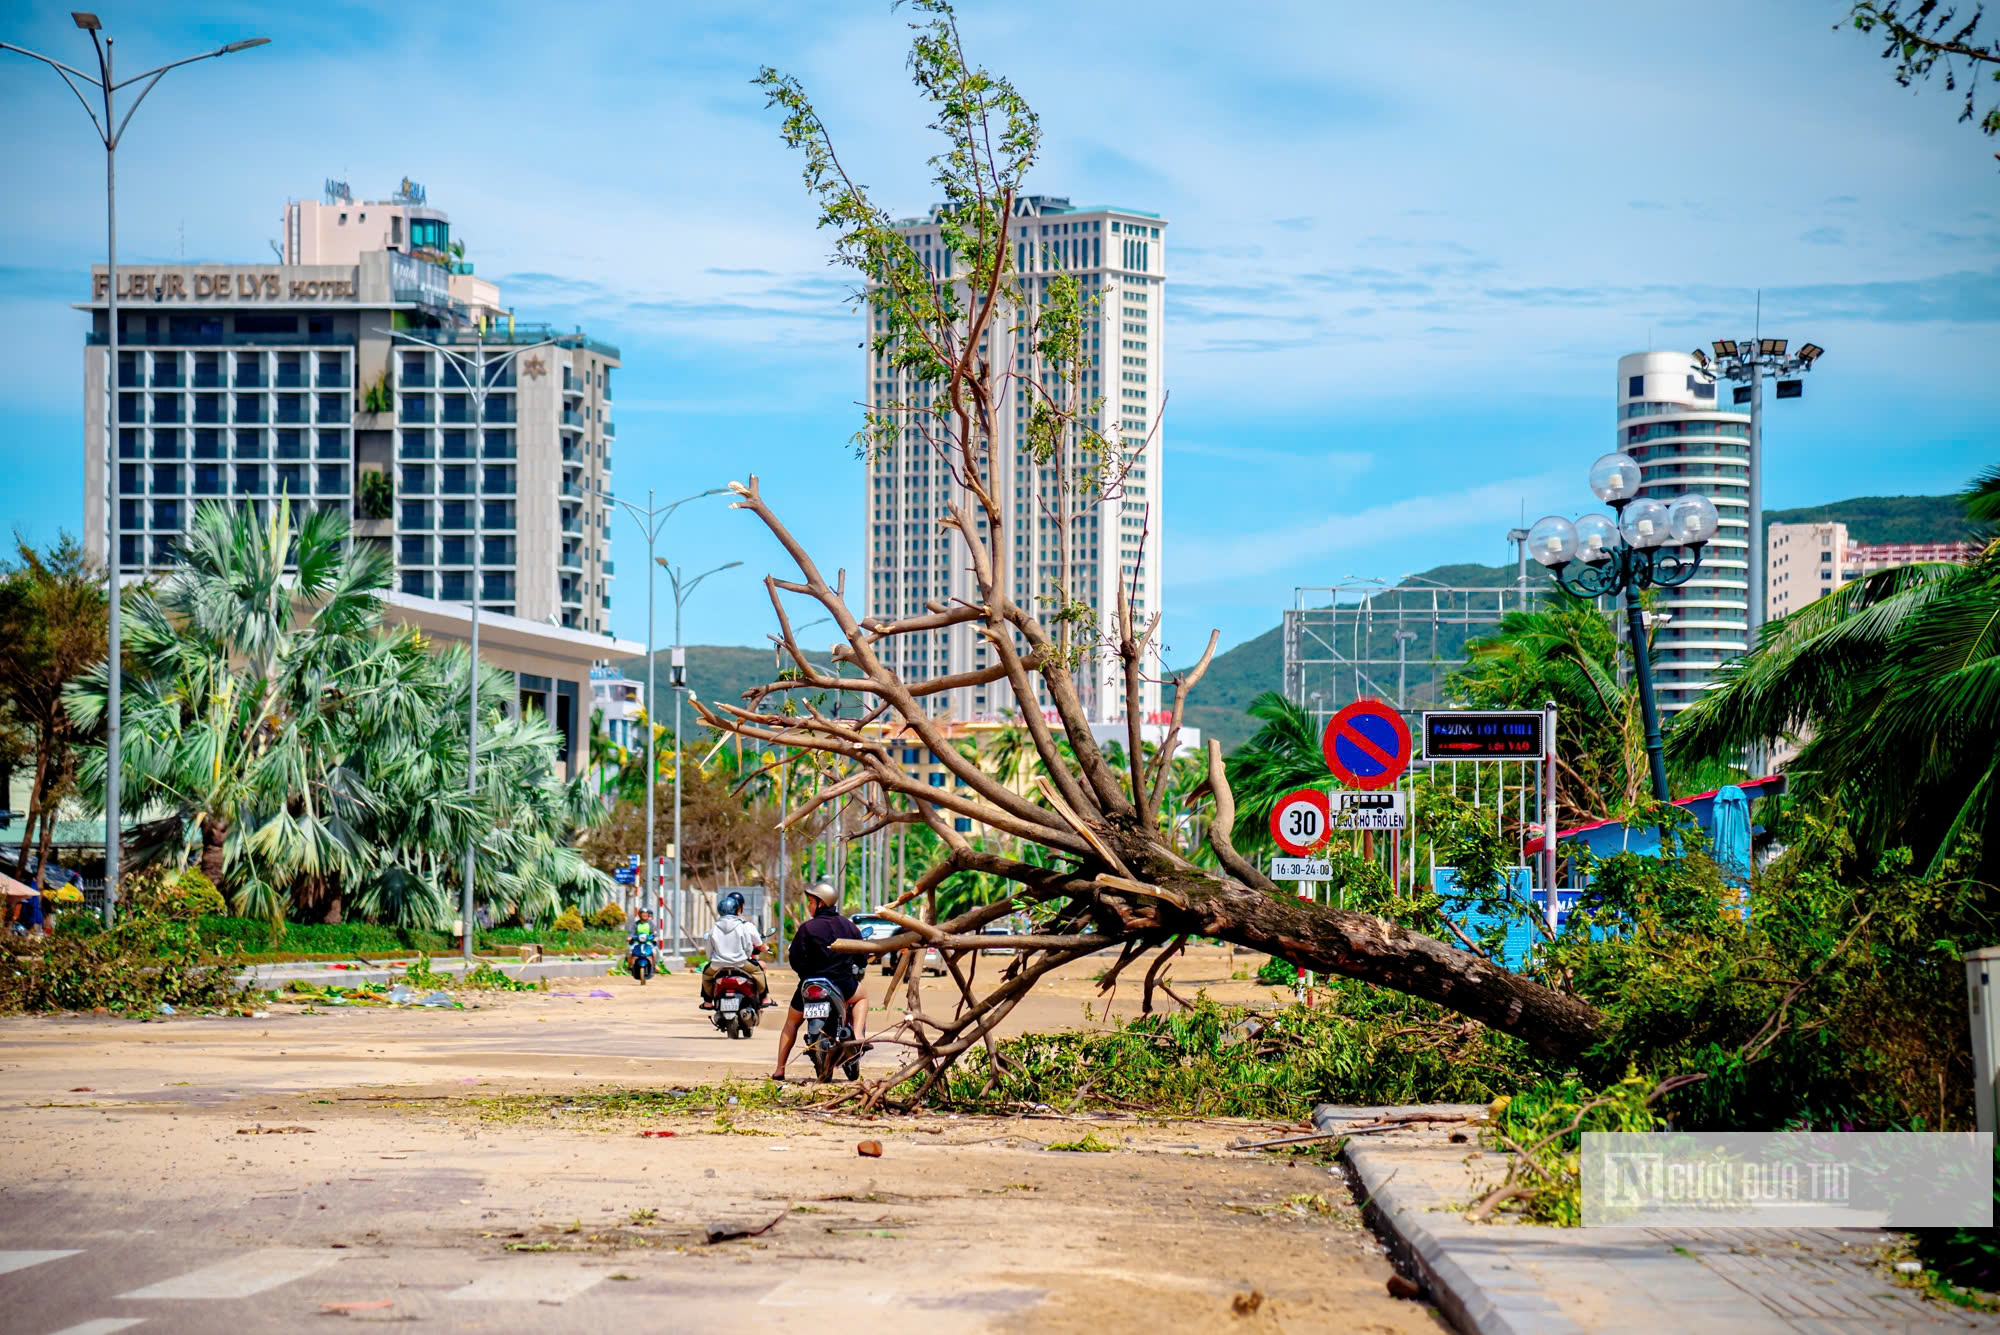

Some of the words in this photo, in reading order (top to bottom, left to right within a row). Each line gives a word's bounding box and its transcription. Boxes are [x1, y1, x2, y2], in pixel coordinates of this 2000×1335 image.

[94, 273, 187, 298] FLEUR
[194, 273, 232, 298] DE
[238, 273, 281, 298] LYS
[288, 280, 357, 298] HOTEL
[1289, 810, 1316, 836] 30
[1389, 811, 1404, 828] LÊN
